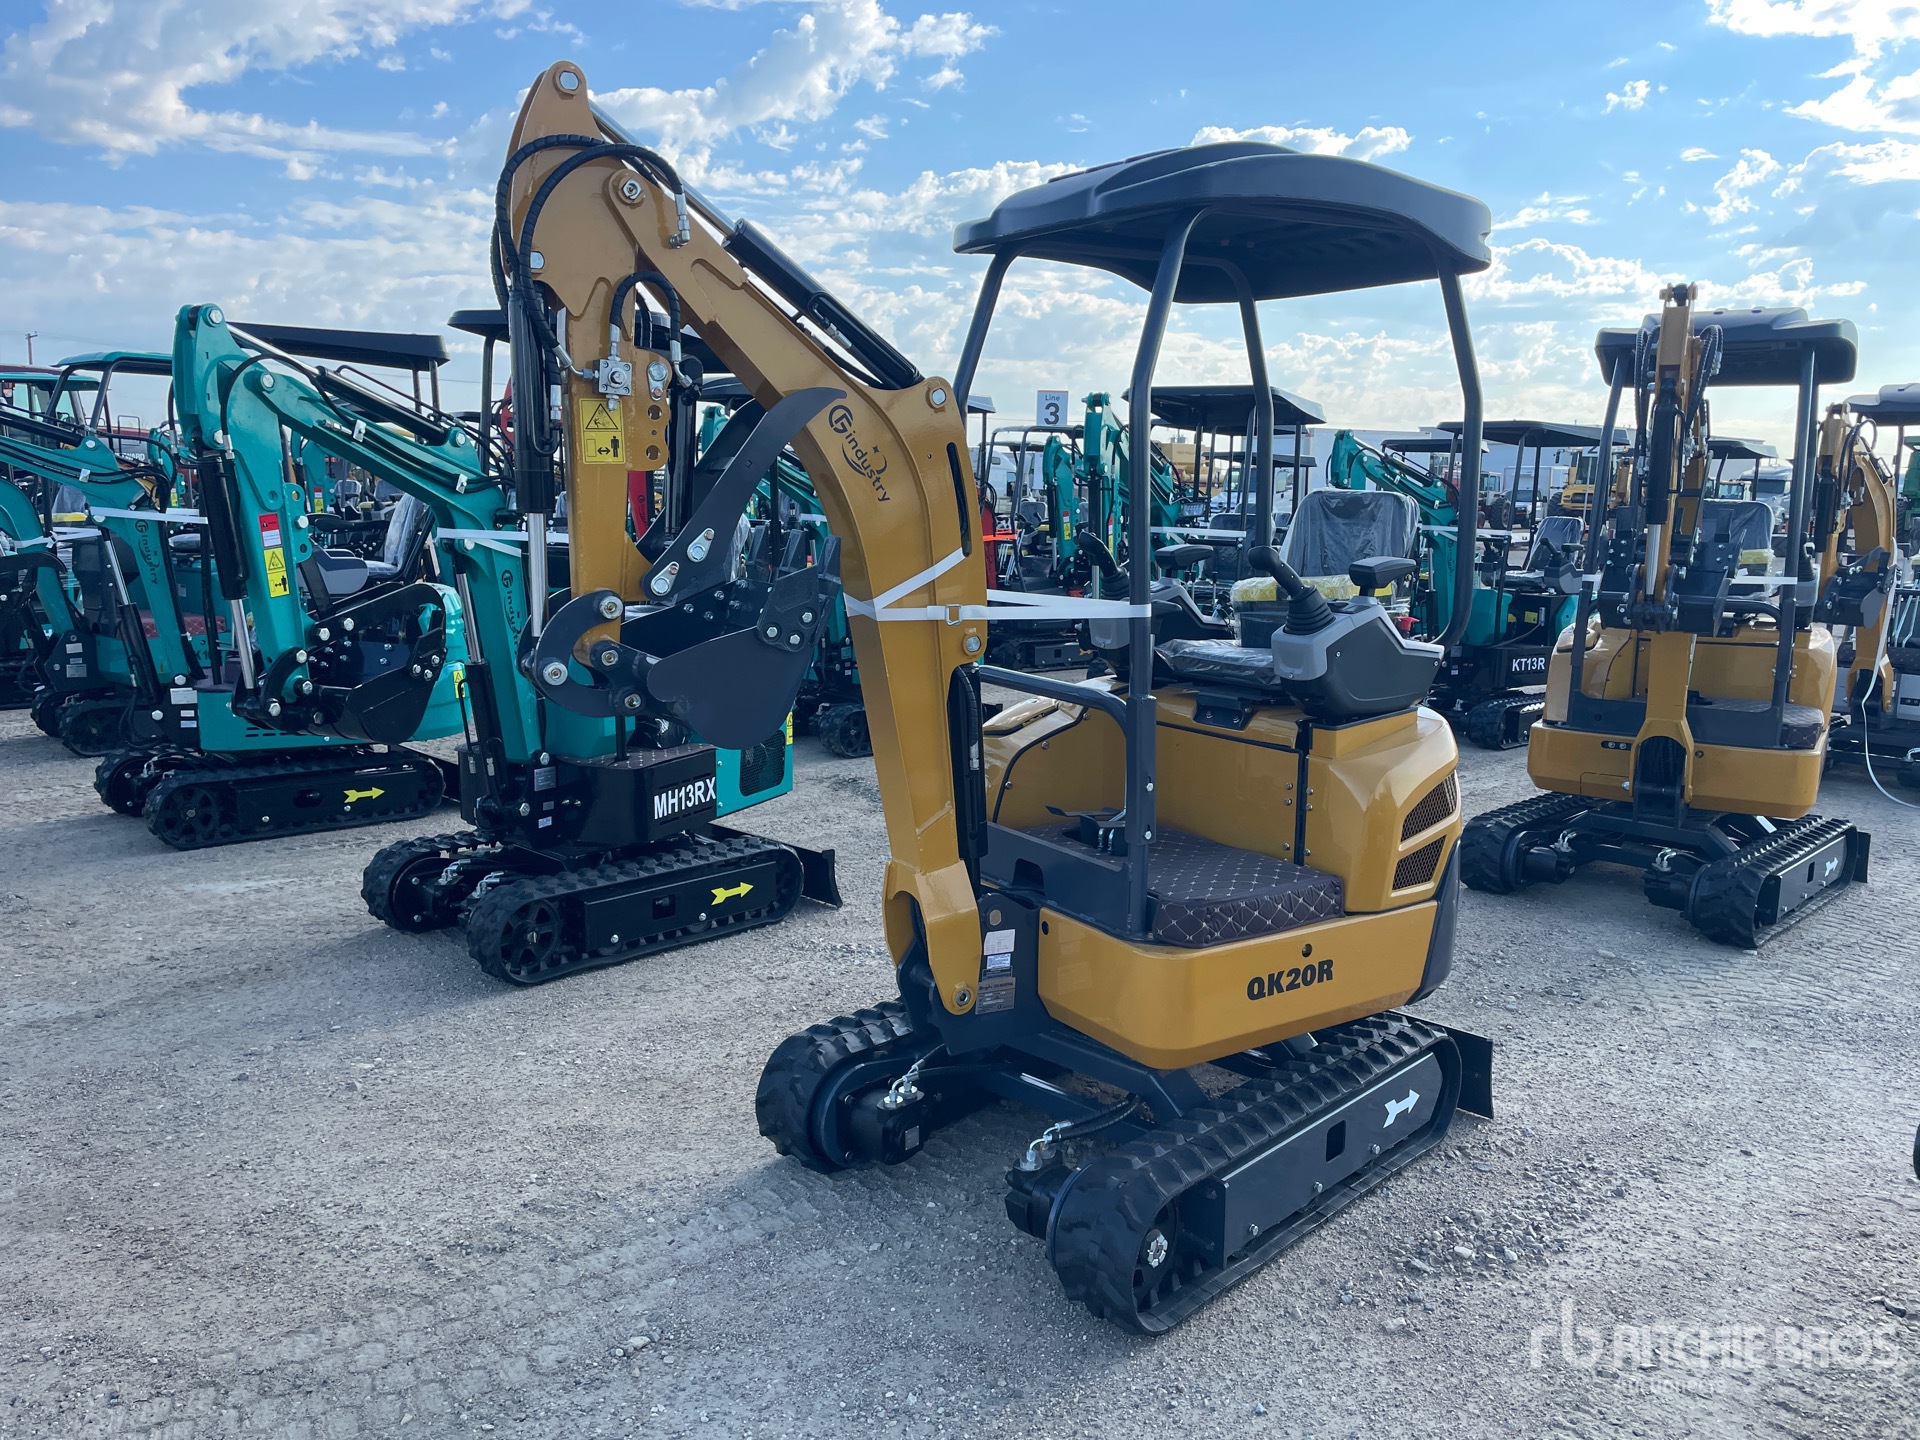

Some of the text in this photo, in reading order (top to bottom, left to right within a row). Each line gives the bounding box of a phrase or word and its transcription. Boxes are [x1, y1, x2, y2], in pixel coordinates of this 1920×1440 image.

[1044, 402, 1060, 425] 3
[1512, 657, 1546, 671] KT13R
[654, 776, 716, 820] MH13RX
[1247, 959, 1333, 1000] QK20R
